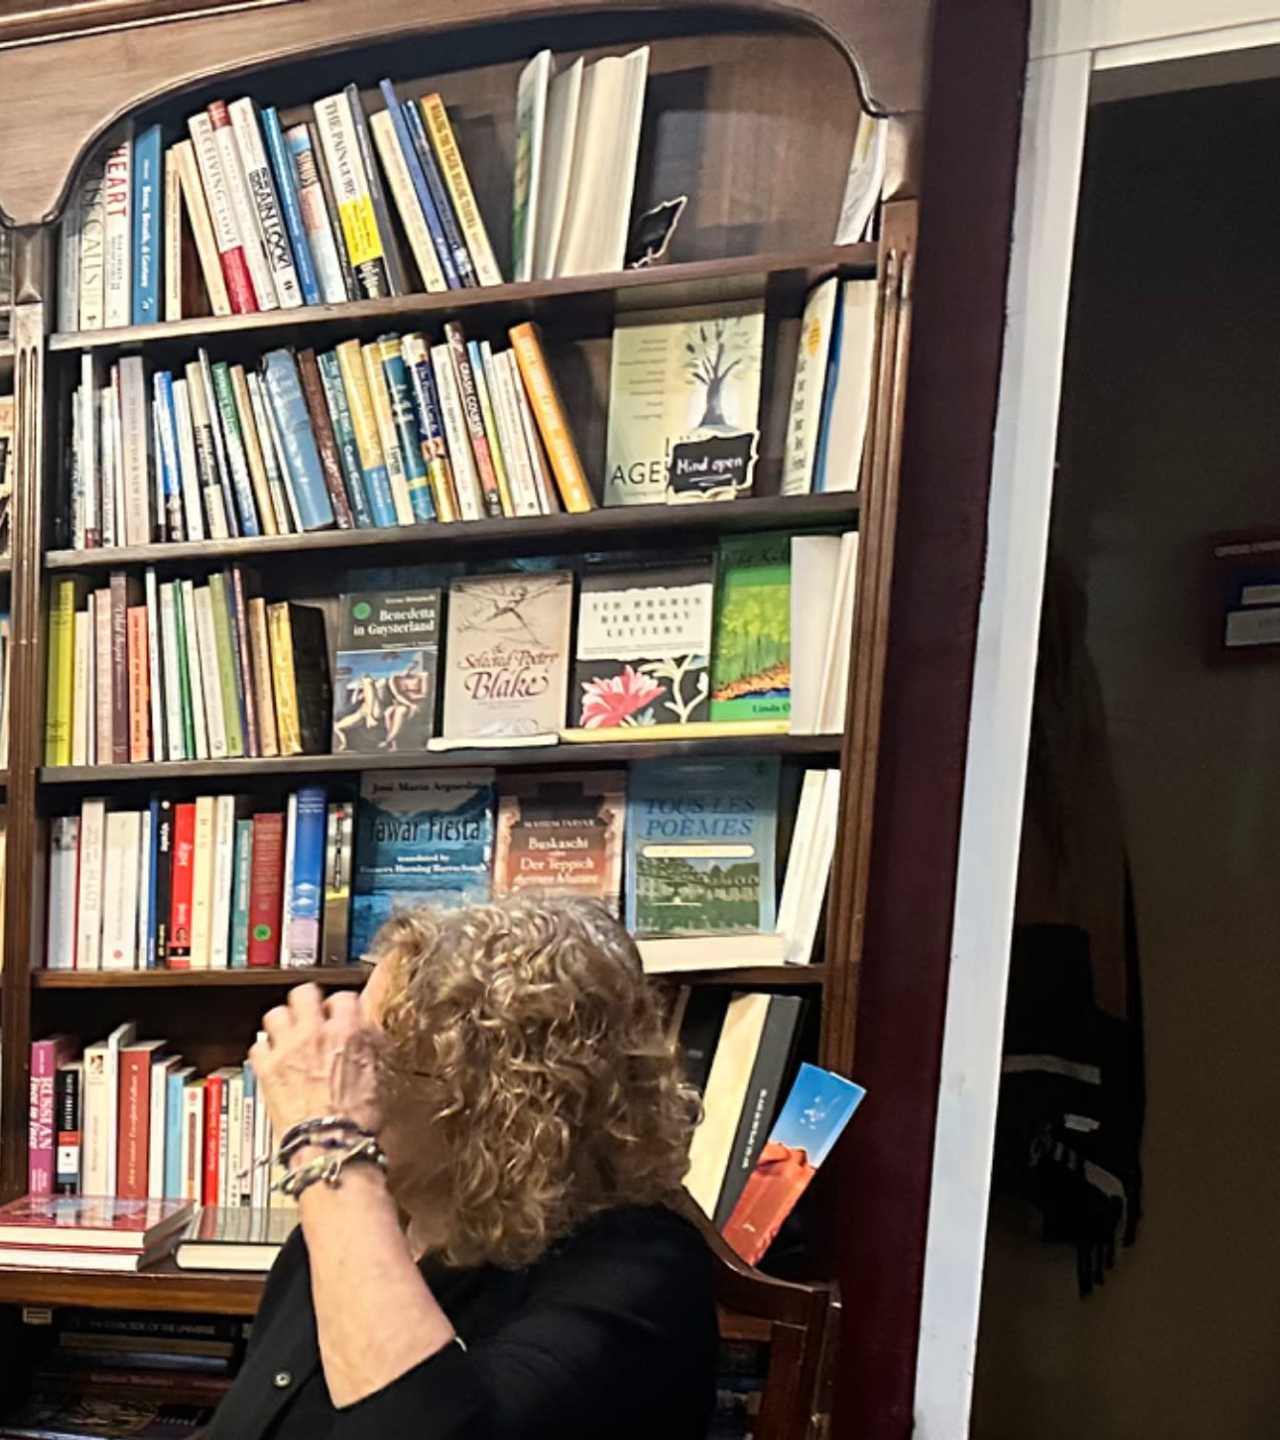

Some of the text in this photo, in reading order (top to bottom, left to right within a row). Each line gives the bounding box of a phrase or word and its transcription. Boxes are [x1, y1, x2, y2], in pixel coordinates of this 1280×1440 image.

[106, 142, 130, 218] HEART
[609, 461, 662, 487] AGE
[379, 608, 436, 622] Benedetta
[353, 624, 365, 637] in
[464, 671, 549, 701] Blake
[644, 798, 708, 815] TOUS
[426, 816, 481, 842] Fiesta
[645, 815, 754, 837] POÈMES
[528, 836, 589, 850] Buskaschi
[520, 857, 594, 872] Der Teppich
[40, 1076, 54, 1150] RUSSIAN
